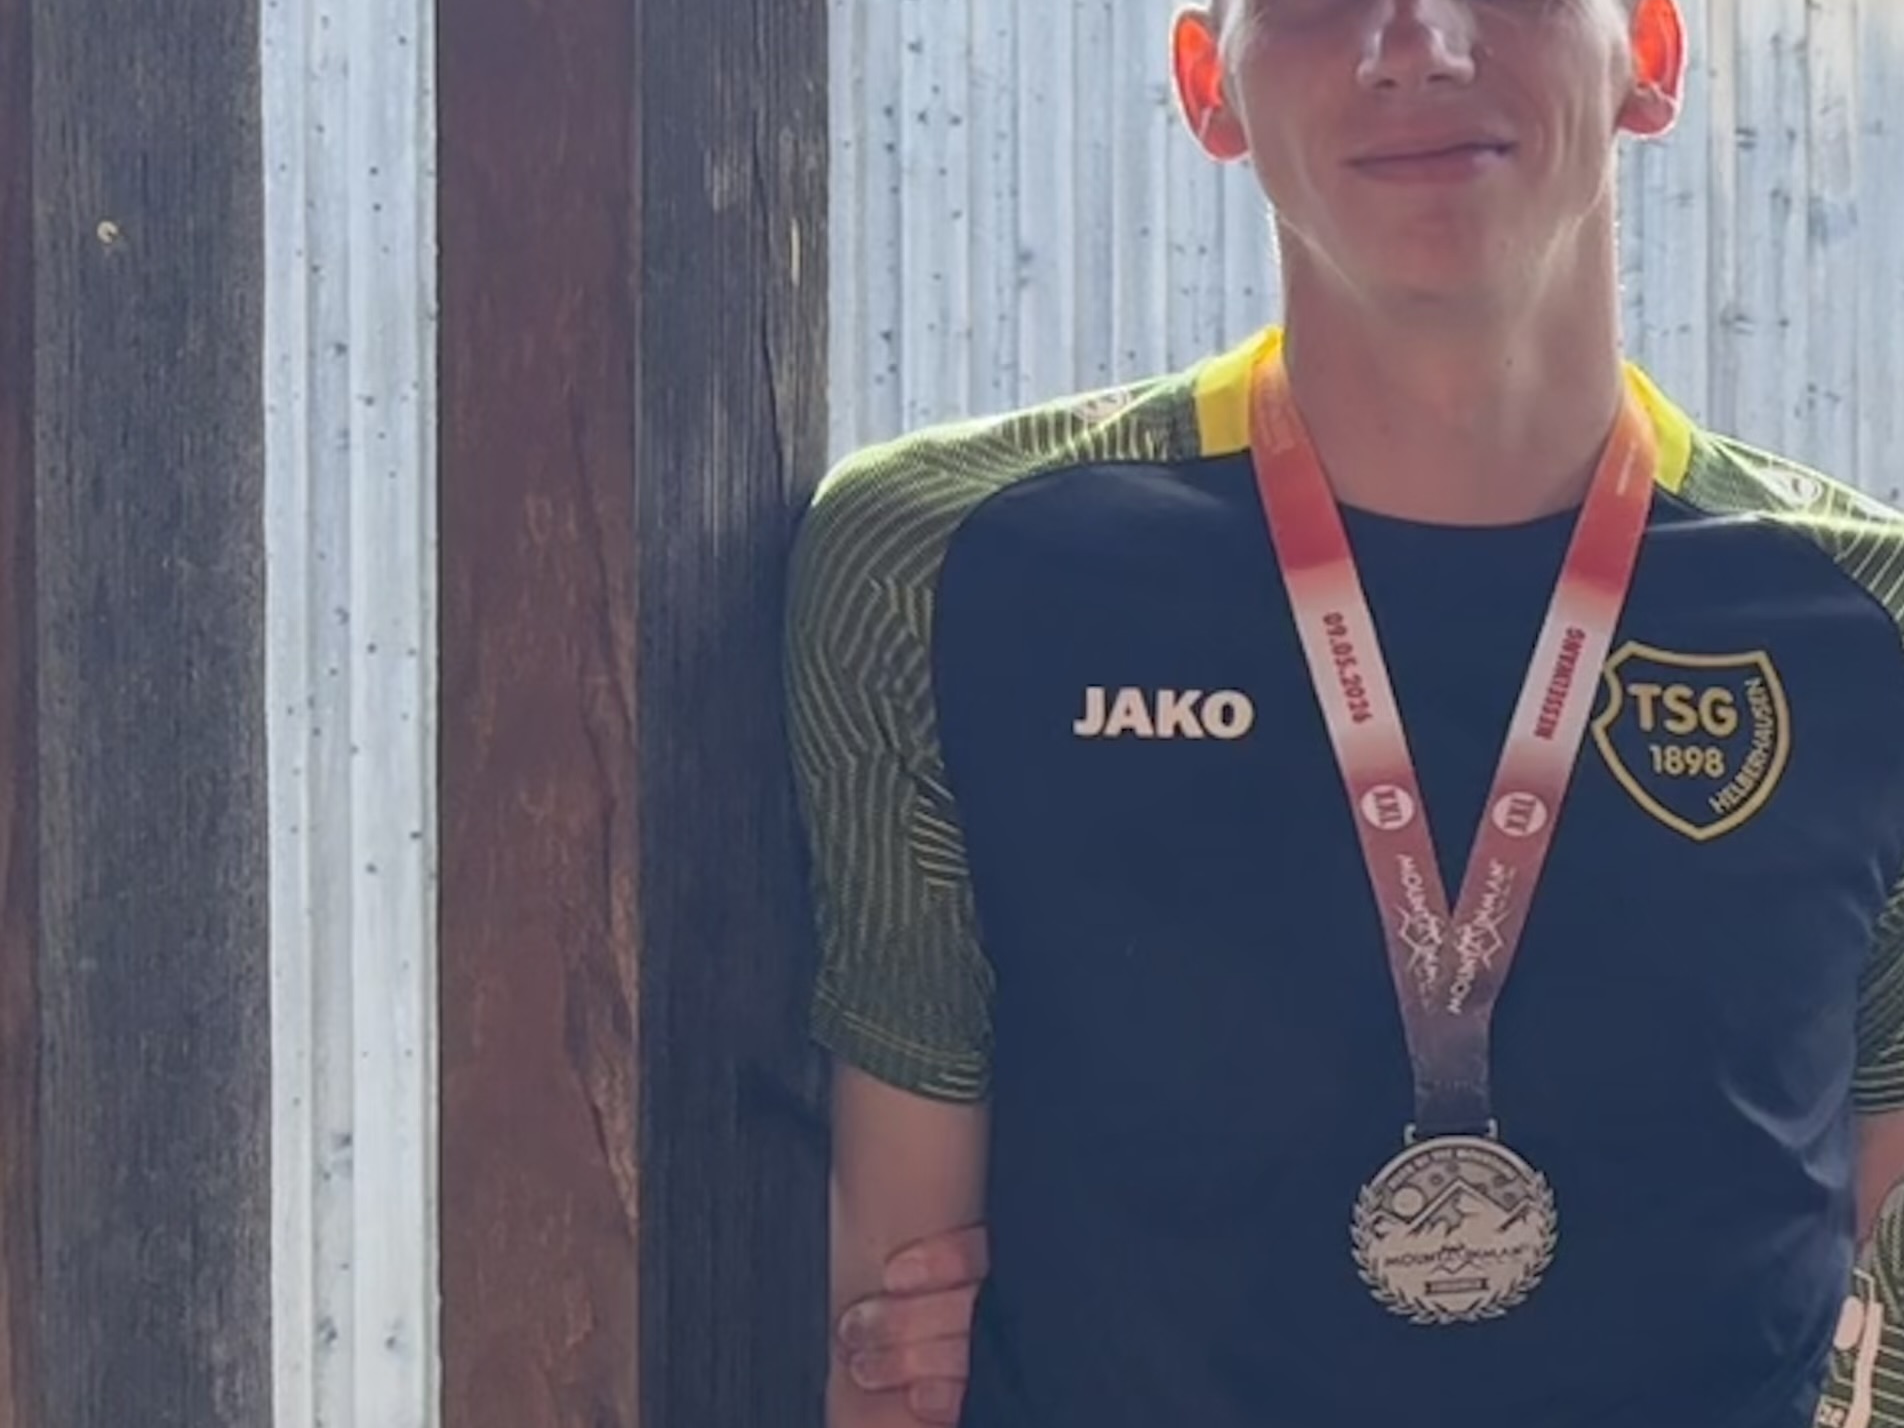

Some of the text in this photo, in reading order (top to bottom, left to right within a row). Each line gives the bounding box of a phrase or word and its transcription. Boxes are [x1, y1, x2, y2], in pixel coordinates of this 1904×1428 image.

[1533, 627, 1585, 740] NESSELWANG
[1627, 683, 1738, 736] TSG
[1074, 686, 1253, 740] JAKO
[1649, 743, 1726, 778] 1898
